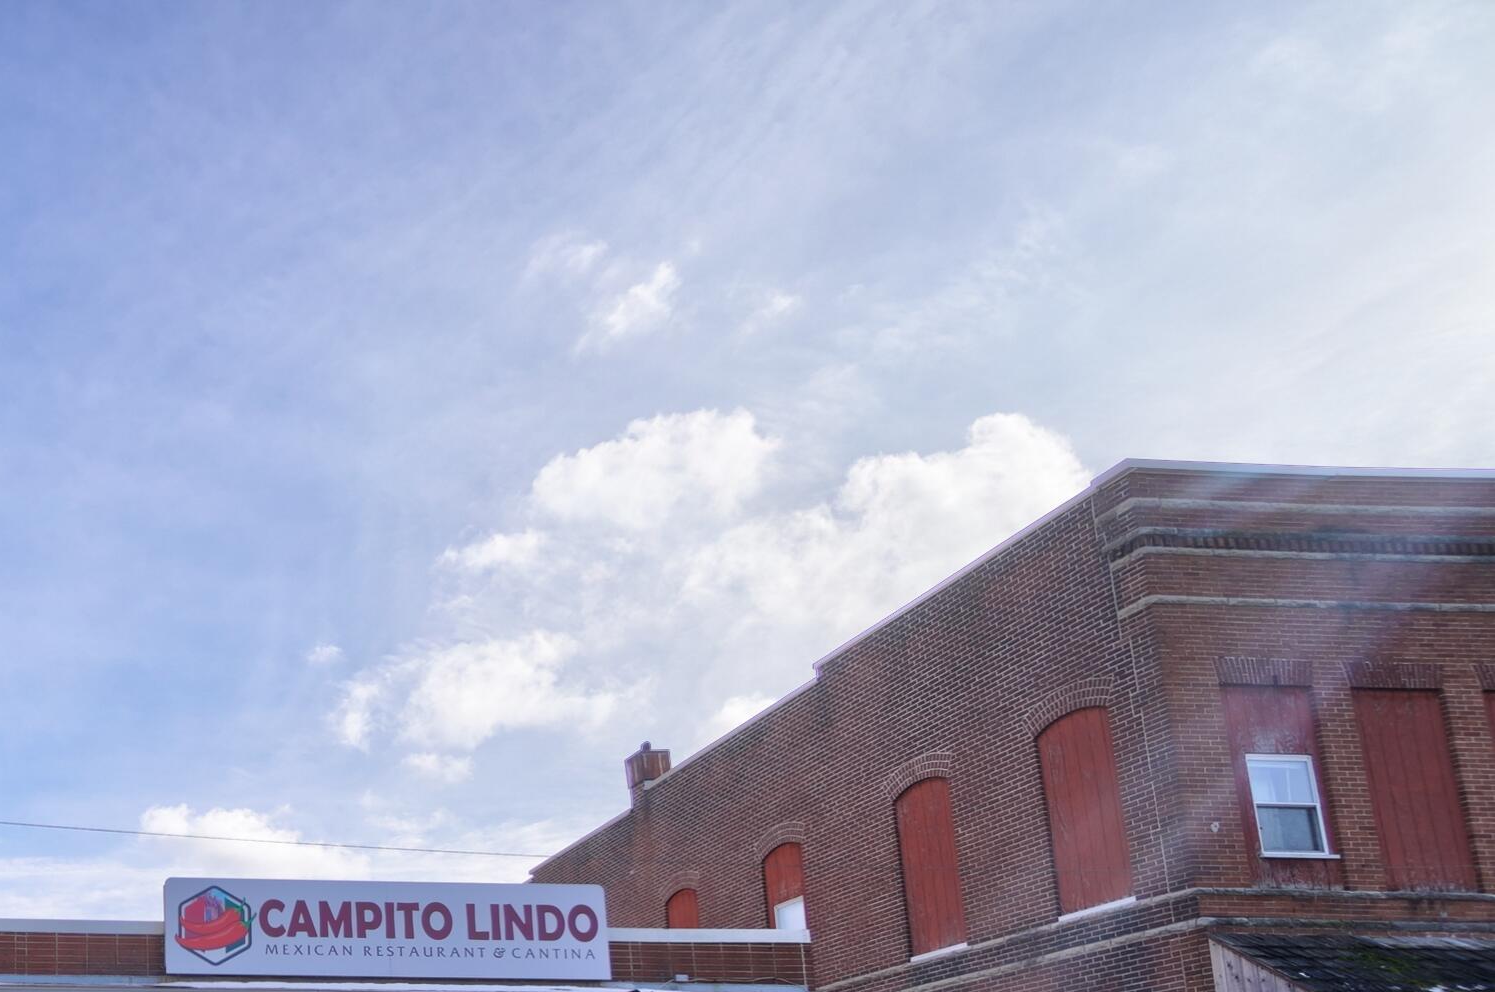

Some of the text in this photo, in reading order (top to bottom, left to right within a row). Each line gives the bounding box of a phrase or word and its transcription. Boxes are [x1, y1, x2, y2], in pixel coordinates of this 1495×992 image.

[258, 898, 599, 943] CAMPITO LINDO
[264, 943, 596, 960] MEXICAN RESTAURANT & CANTINA
